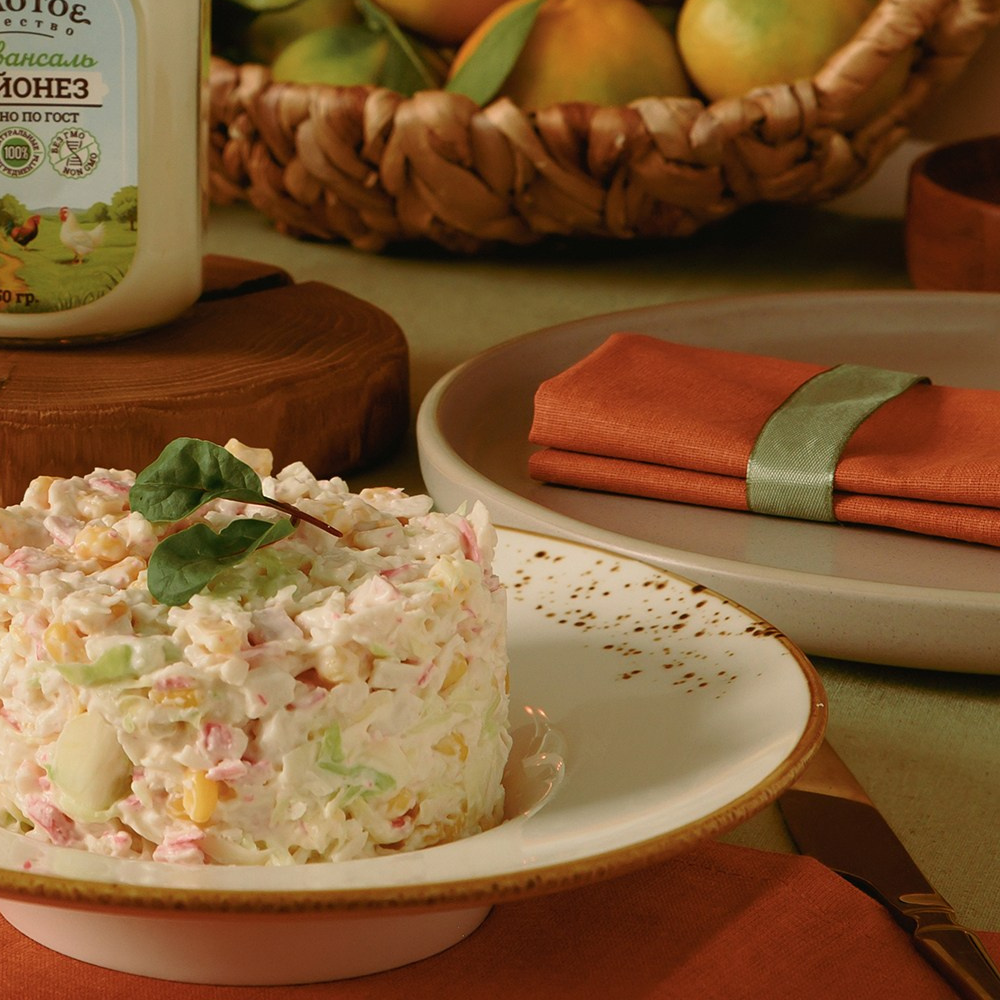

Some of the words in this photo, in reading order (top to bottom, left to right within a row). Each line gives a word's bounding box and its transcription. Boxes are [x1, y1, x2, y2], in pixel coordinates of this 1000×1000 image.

[22, 111, 42, 122] ПО
[45, 111, 80, 123] ГОСТ
[51, 136, 63, 153] БЕЗ
[63, 130, 85, 140] ГМО
[4, 145, 29, 160] 100%
[62, 166, 83, 175] NON
[85, 152, 97, 171] GMO
[16, 292, 40, 306] гр.
